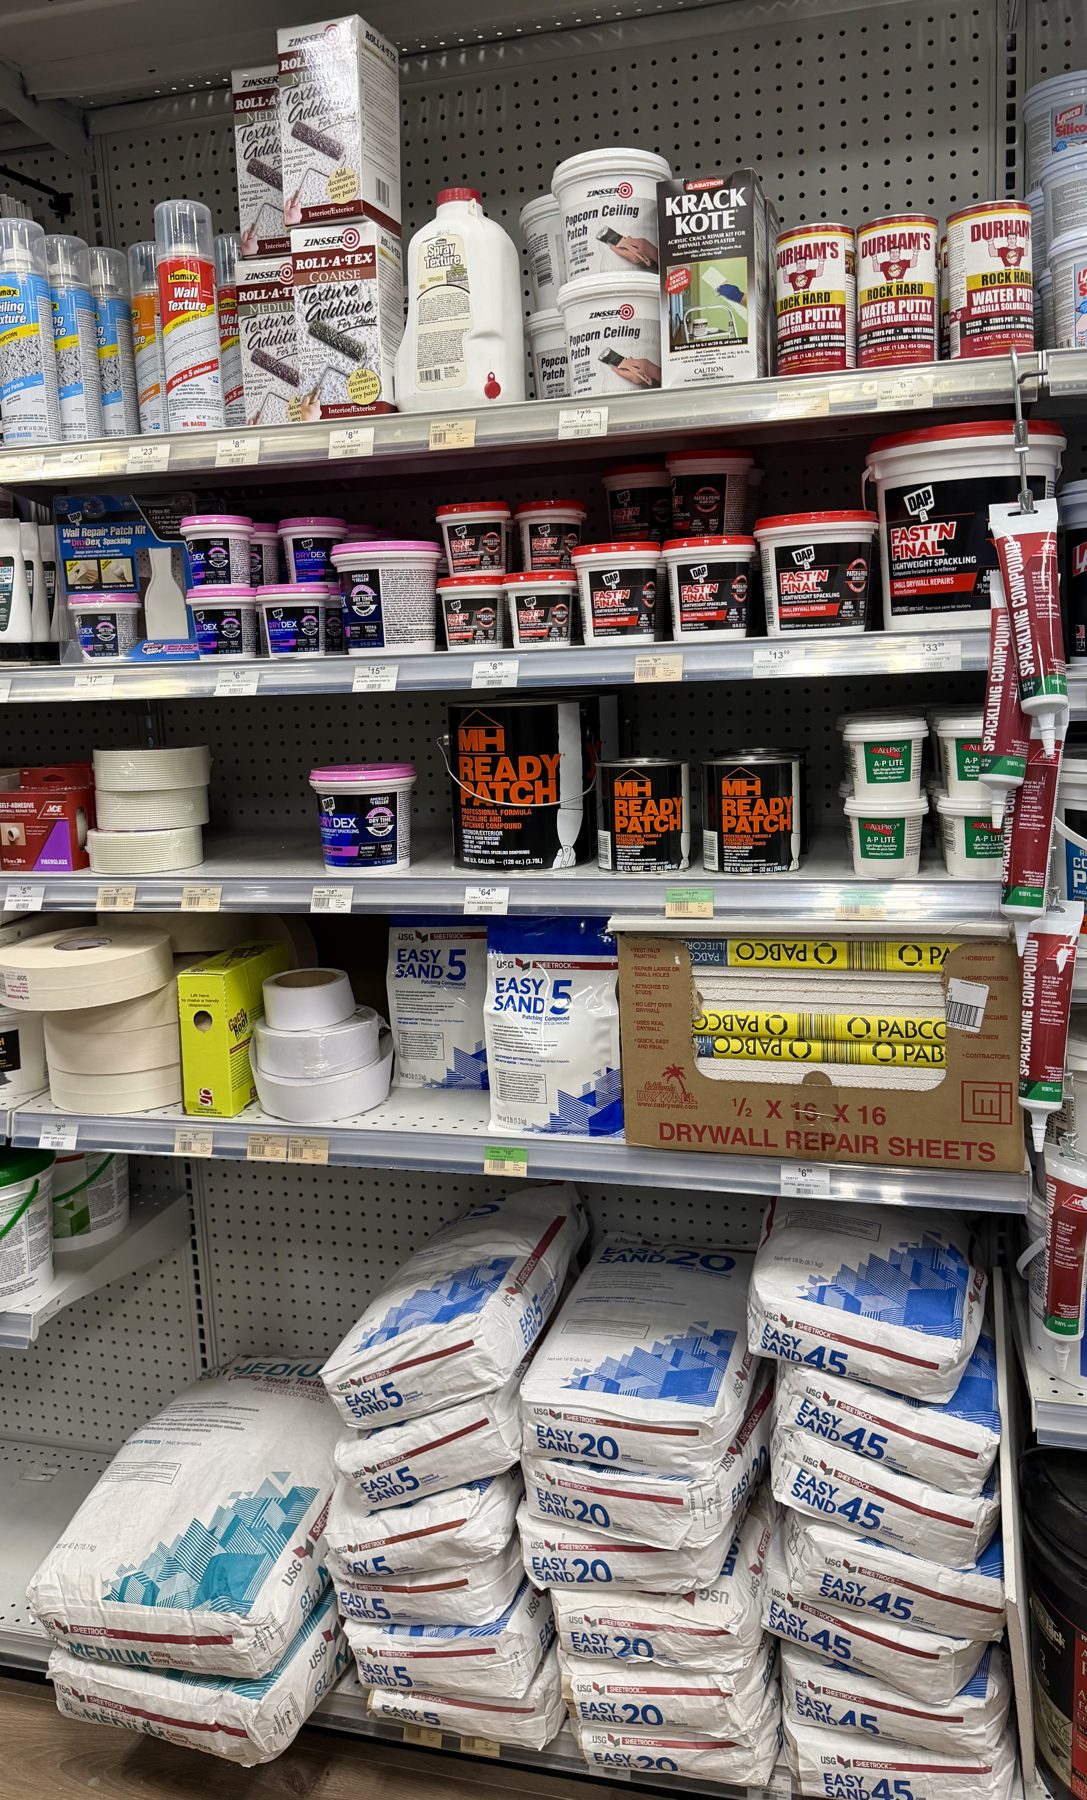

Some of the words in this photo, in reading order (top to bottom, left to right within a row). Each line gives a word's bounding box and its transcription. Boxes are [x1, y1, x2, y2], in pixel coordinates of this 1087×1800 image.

[242, 75, 280, 88] ZINSSER
[693, 179, 724, 190] ABATRON
[587, 188, 620, 198] ZINSSER
[665, 187, 747, 216] KRACK
[309, 206, 355, 219] Interior/Exterior
[565, 209, 598, 228] Popcorn
[601, 204, 640, 219] Ceiling
[675, 209, 736, 236] KOTE
[567, 225, 588, 240] Patch
[667, 236, 689, 245] ACRYLIC
[689, 234, 706, 242] CRACK
[707, 232, 726, 240] REPAIR
[726, 231, 735, 239] KIT
[736, 230, 746, 238] FOR
[304, 236, 344, 248] ZINSSER
[427, 243, 456, 257] Spray
[677, 242, 701, 250] DRYWALL
[714, 237, 736, 246] PLASTER
[861, 232, 931, 260] DURHAM'S
[424, 254, 461, 270] Texture
[777, 242, 840, 270] DURHAM'S
[169, 272, 199, 282] Homax
[309, 269, 361, 284] COARSE
[981, 272, 1011, 287] ROCK
[173, 286, 198, 299] Wall
[297, 284, 359, 305] Texture
[802, 291, 831, 305] HARD
[867, 285, 894, 301] ROCK
[896, 282, 924, 296] HARD
[972, 288, 1014, 307] WATER
[168, 300, 207, 314] Texture
[304, 300, 374, 323] Additive
[589, 309, 621, 320] ZINSSER
[805, 307, 841, 322] PUTTY
[861, 301, 896, 322] WATER
[902, 299, 932, 314] PUTTY
[569, 331, 600, 347] Popcorn
[603, 326, 641, 340] Ceiling
[570, 345, 591, 360] Patch
[354, 370, 368, 379] Add
[542, 368, 565, 382] Patch
[693, 365, 724, 375] CAUTION
[348, 376, 378, 386] decorative
[350, 384, 372, 393] texture
[352, 393, 363, 401] any
[363, 389, 379, 400] paint
[328, 404, 377, 415] Interior/Exterior
[62, 527, 80, 538] Wall
[81, 527, 108, 538] Repair
[110, 526, 133, 536] Patch
[134, 525, 147, 536] Kit
[891, 521, 957, 544] FAST'N
[102, 537, 132, 546] Spackling
[295, 551, 326, 559] DRYDEX
[891, 540, 946, 561] FINAL
[892, 559, 933, 571] LIGHTWEIGHT
[934, 556, 977, 567] SPACKLING
[781, 570, 829, 583] FAST'N
[930, 576, 954, 586] REPAIRS
[1004, 540, 1028, 607] COMPOUND
[681, 583, 719, 595] FAST'N
[781, 581, 821, 594] FINAL
[682, 593, 713, 603] FINAL
[781, 593, 811, 601] LIGHTWEIGHT
[1013, 609, 1036, 677] SPACKLING
[458, 729, 505, 752] MH
[459, 753, 561, 782] READY
[888, 759, 904, 767] LITE
[460, 780, 557, 807] PATCH
[614, 781, 652, 797] MH
[46, 805, 63, 813] ACE
[461, 808, 499, 816] PROFESSIONAL
[500, 808, 533, 816] FORMULA
[614, 797, 683, 816] READY
[320, 816, 358, 829] DRYDEX
[485, 822, 522, 830] COMPOUND
[489, 815, 502, 823] AND
[615, 814, 682, 833] PATCH
[40, 858, 68, 866] FIBERGLASS
[398, 932, 415, 941] USG
[433, 932, 465, 940] SHEETROCK
[397, 948, 442, 964] EASY
[736, 942, 807, 963] PABCO
[394, 963, 444, 979] SAND
[445, 949, 467, 981] 5
[496, 961, 514, 969] USG
[535, 961, 573, 969] SHEETROCK
[1022, 939, 1039, 1008] COMPOUND
[495, 977, 545, 996] EASY
[493, 996, 545, 1014] SAND
[549, 979, 573, 1015] 5
[522, 1014, 543, 1022] Patching
[544, 1015, 570, 1023] Compound
[692, 1013, 759, 1034] PABCO
[713, 1037, 782, 1055] PABCO
[1020, 1010, 1035, 1077] SPACKLING
[637, 1101, 699, 1111] www.cadrywall.com
[766, 1099, 783, 1120] X
[790, 1101, 816, 1121] 16
[833, 1103, 850, 1125] X
[858, 1106, 887, 1126] 16
[659, 1122, 779, 1150] DRYWALL
[785, 1130, 879, 1155] REPAIR
[887, 1135, 996, 1163] SHEETS
[665, 1249, 738, 1273] 20
[763, 1310, 779, 1322] USG
[797, 1323, 832, 1340] SHEETROCK
[763, 1324, 803, 1350] EASY
[760, 1339, 803, 1362] SAND
[804, 1345, 849, 1378] 45
[336, 1380, 352, 1391] USG
[363, 1368, 393, 1382] SHEETROCK
[344, 1389, 379, 1409] EASY
[351, 1400, 389, 1420] SAND
[380, 1382, 404, 1408] 5
[533, 1407, 549, 1416] USG
[565, 1414, 598, 1425] SHEETROCK
[799, 1398, 844, 1430] EASY
[536, 1425, 574, 1442] EASY
[794, 1411, 842, 1442] SAND
[840, 1427, 889, 1461] 45
[537, 1438, 580, 1455] SAND
[578, 1432, 619, 1461] 20
[531, 1556, 568, 1571] EASY
[534, 1570, 576, 1583] SAND
[572, 1558, 613, 1583] 20
[282, 1559, 303, 1588] USG
[770, 1599, 809, 1631] EASY
[769, 1617, 811, 1644] SAND
[809, 1629, 853, 1660] 45
[68, 1641, 150, 1666] MEDIUM
[149, 1651, 172, 1659] Ceiling
[823, 1772, 865, 1789] EASY
[870, 1779, 916, 1800] 45
